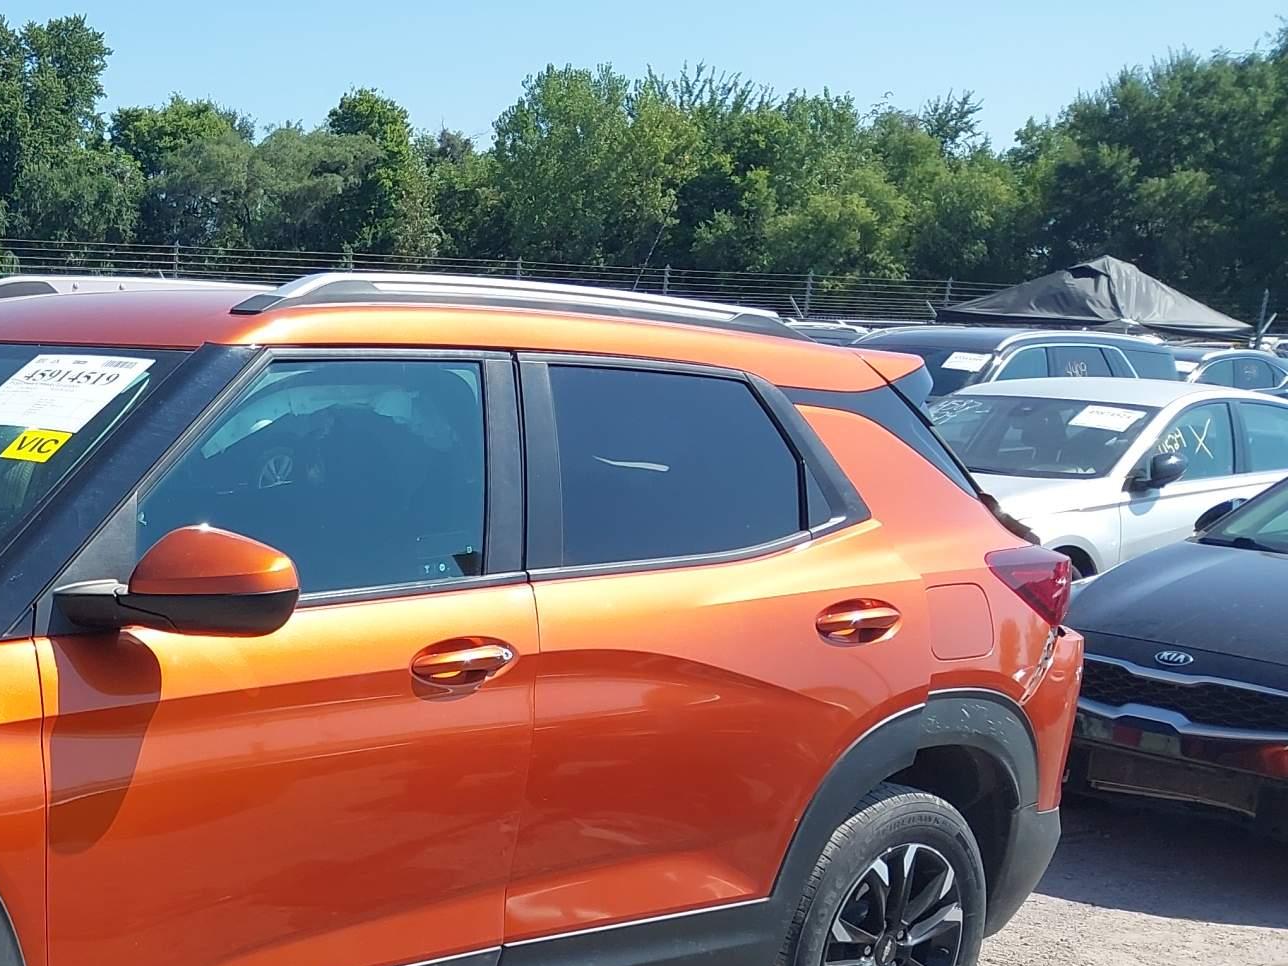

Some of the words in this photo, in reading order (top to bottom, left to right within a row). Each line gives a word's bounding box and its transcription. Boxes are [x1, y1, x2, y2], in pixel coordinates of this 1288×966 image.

[23, 368, 120, 386] 45914519
[16, 435, 60, 455] VIC
[1159, 651, 1186, 663] KIA
